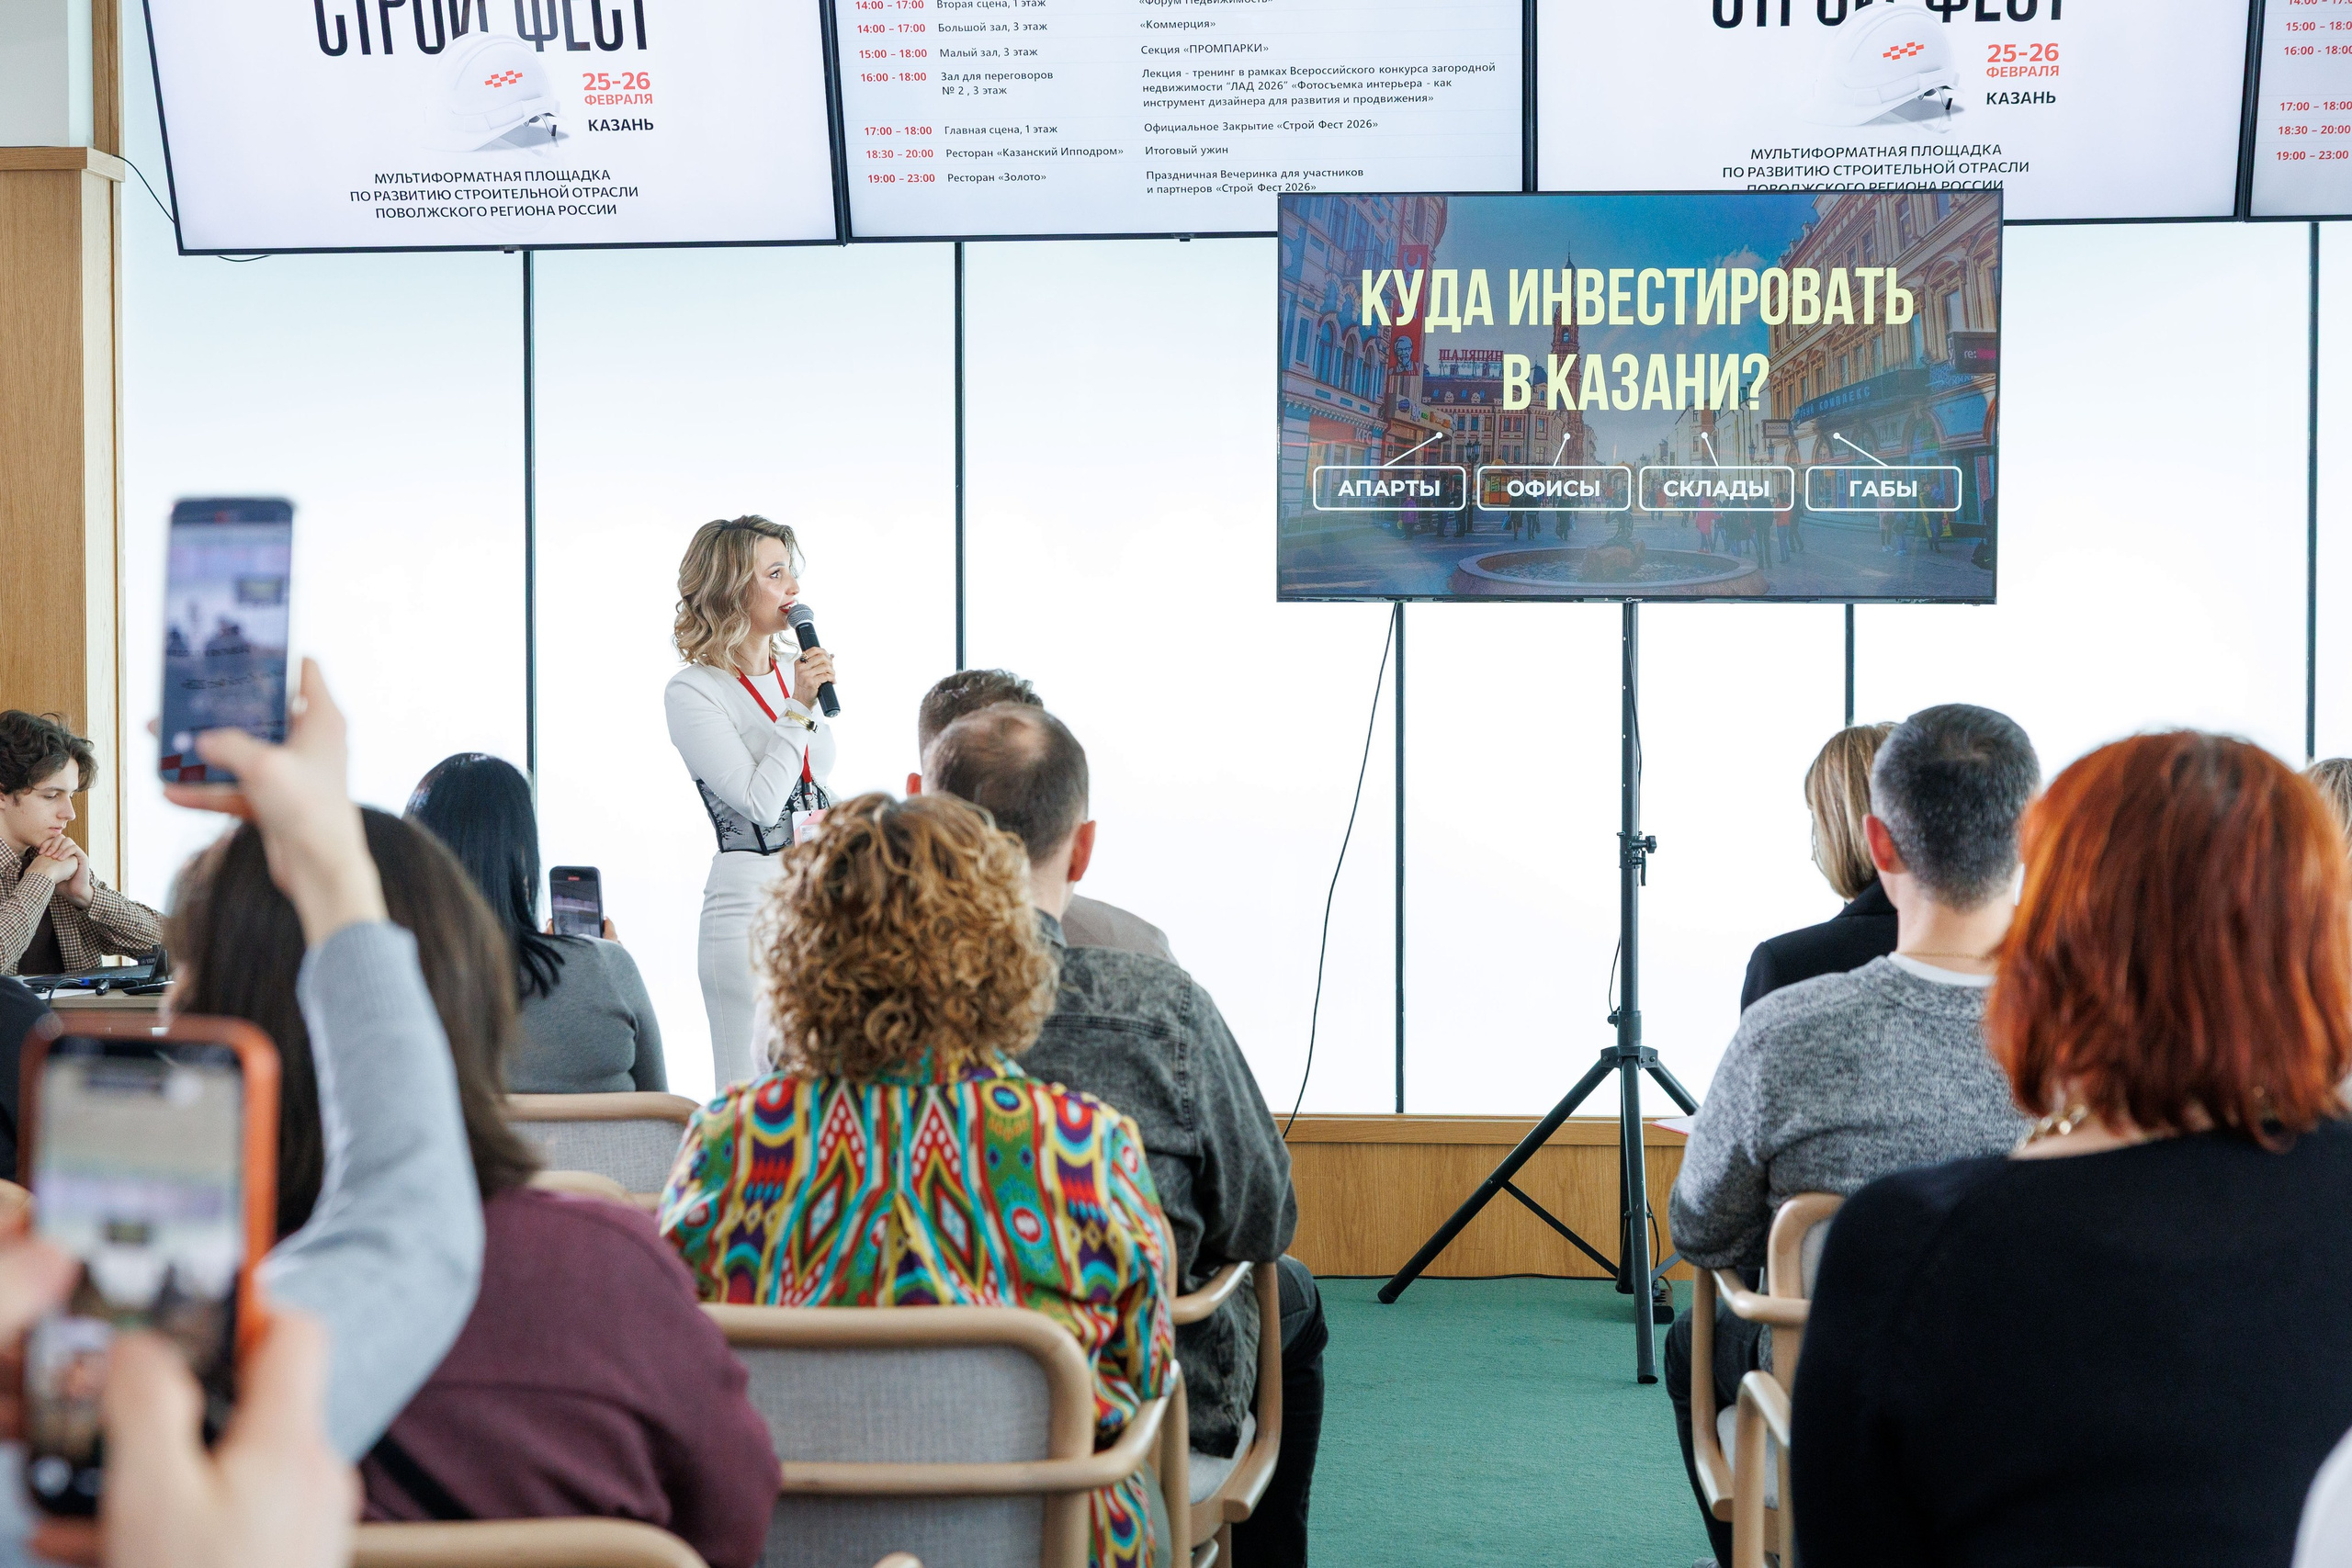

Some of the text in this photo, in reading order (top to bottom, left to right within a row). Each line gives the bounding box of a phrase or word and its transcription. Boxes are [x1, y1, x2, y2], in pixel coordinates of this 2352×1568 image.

[855, 0, 883, 9] 14:00
[896, 0, 923, 8] 17:00
[936, 0, 973, 10] Вторая
[976, 0, 1010, 9] сцена,
[856, 24, 885, 33] 14:00
[897, 23, 925, 32] 17:00
[938, 21, 986, 32] Большой
[989, 24, 1010, 32] зал,
[1013, 21, 1019, 30] 3
[1139, 19, 1216, 30] «Коммерция»
[2286, 21, 2315, 31] 15:00
[859, 49, 887, 58] 15:00
[899, 49, 927, 58] 18:00
[939, 47, 977, 57] Малый
[1003, 47, 1009, 56] 3
[1140, 43, 1268, 55] Секция «ПРОМПАРКИ»
[1987, 42, 2059, 62] 25-26
[2284, 45, 2313, 55] 16:00
[1141, 68, 1181, 79] Лекция
[1192, 69, 1235, 79] тренинг
[1248, 68, 1286, 78] рамках
[1290, 64, 1374, 77] Всероссийского
[1379, 65, 1428, 75] конкурса
[1431, 62, 1495, 74] загородной
[1985, 65, 2059, 77] ФЕВРАЛЯ
[582, 71, 651, 91] 25-26
[860, 73, 888, 82] 16:00
[899, 72, 926, 81] 18:00
[941, 72, 1053, 82] Зал для переговоров
[942, 85, 954, 95] №
[957, 85, 964, 95] 2
[973, 85, 978, 95] 3
[1142, 84, 1222, 94] недвижимости
[1291, 80, 1363, 89] «Фотосъемка
[1366, 80, 1421, 90] интерьера
[583, 93, 652, 105] ФЕВРАЛЯ
[1143, 99, 1204, 108] инструмент
[1208, 96, 1265, 107] дизайнера
[1268, 97, 1287, 107] для
[1291, 96, 1340, 107] развития
[1352, 95, 1433, 106] продвижения»
[1986, 91, 2055, 105] КАЗАНЬ
[2279, 101, 2309, 110] 17:00
[588, 118, 653, 131] КАЗАНЬ
[864, 126, 892, 135] 17:00
[904, 126, 932, 135] 18:00
[944, 126, 986, 134] Главная
[989, 127, 1022, 135] сцена,
[1024, 124, 1029, 132] 1
[1144, 118, 1378, 134] Официальное Закрытие «Строй Фест 2026»
[2278, 125, 2307, 135] 18:30
[2320, 124, 2350, 134] 20:00
[865, 149, 893, 158] 18:30
[905, 149, 933, 158] 20:00
[945, 147, 1123, 159] Ресторан «Казанский Ипподром»
[1145, 144, 1227, 156] Итоговый ужин
[1750, 143, 2001, 159] МУЛЬТИФОРМАТНАЯ ПЛОЩАДКА
[2276, 151, 2305, 160] 19:00
[2318, 150, 2348, 159] 23:00
[1723, 159, 2029, 177] ПО РАЗВИТИЮ СТРОИТЕЛЬНОЙ ОТРАСЛИ
[374, 169, 610, 184] МУЛЬТИФОРМАТНАЯ ПЛОЩАДКА
[867, 174, 895, 183] 19:00
[907, 174, 934, 182] 23:00
[947, 172, 1046, 184] Ресторан «Золото»
[1146, 169, 1363, 182] Праздничная Вечеринка для участников
[350, 184, 638, 201] ПО РАЗВИТИЮ СТРОИТЕЛЬНОЙ ОТРАСЛИ
[1157, 186, 1212, 195] партнеров
[1216, 183, 1252, 194] «Строй
[1257, 183, 1283, 192] Фест
[1284, 182, 1317, 192] 2026»
[375, 204, 616, 218] ПОВОЛЖСКОГО РЕГИОНА РОССИИ
[1362, 268, 1494, 333] КУДА
[1509, 267, 1913, 325] ИНВЕСТИРОВАТЬ
[1439, 349, 1503, 361] ШАЛЯПИН
[1503, 353, 1769, 411] В КАЗАНИ?
[1338, 479, 1439, 496] АПАРТЫ
[1507, 479, 1600, 497] ОФИСЫ
[1663, 479, 1769, 500] СКЛАДЫ
[1849, 480, 1917, 496] ГАБЫ
